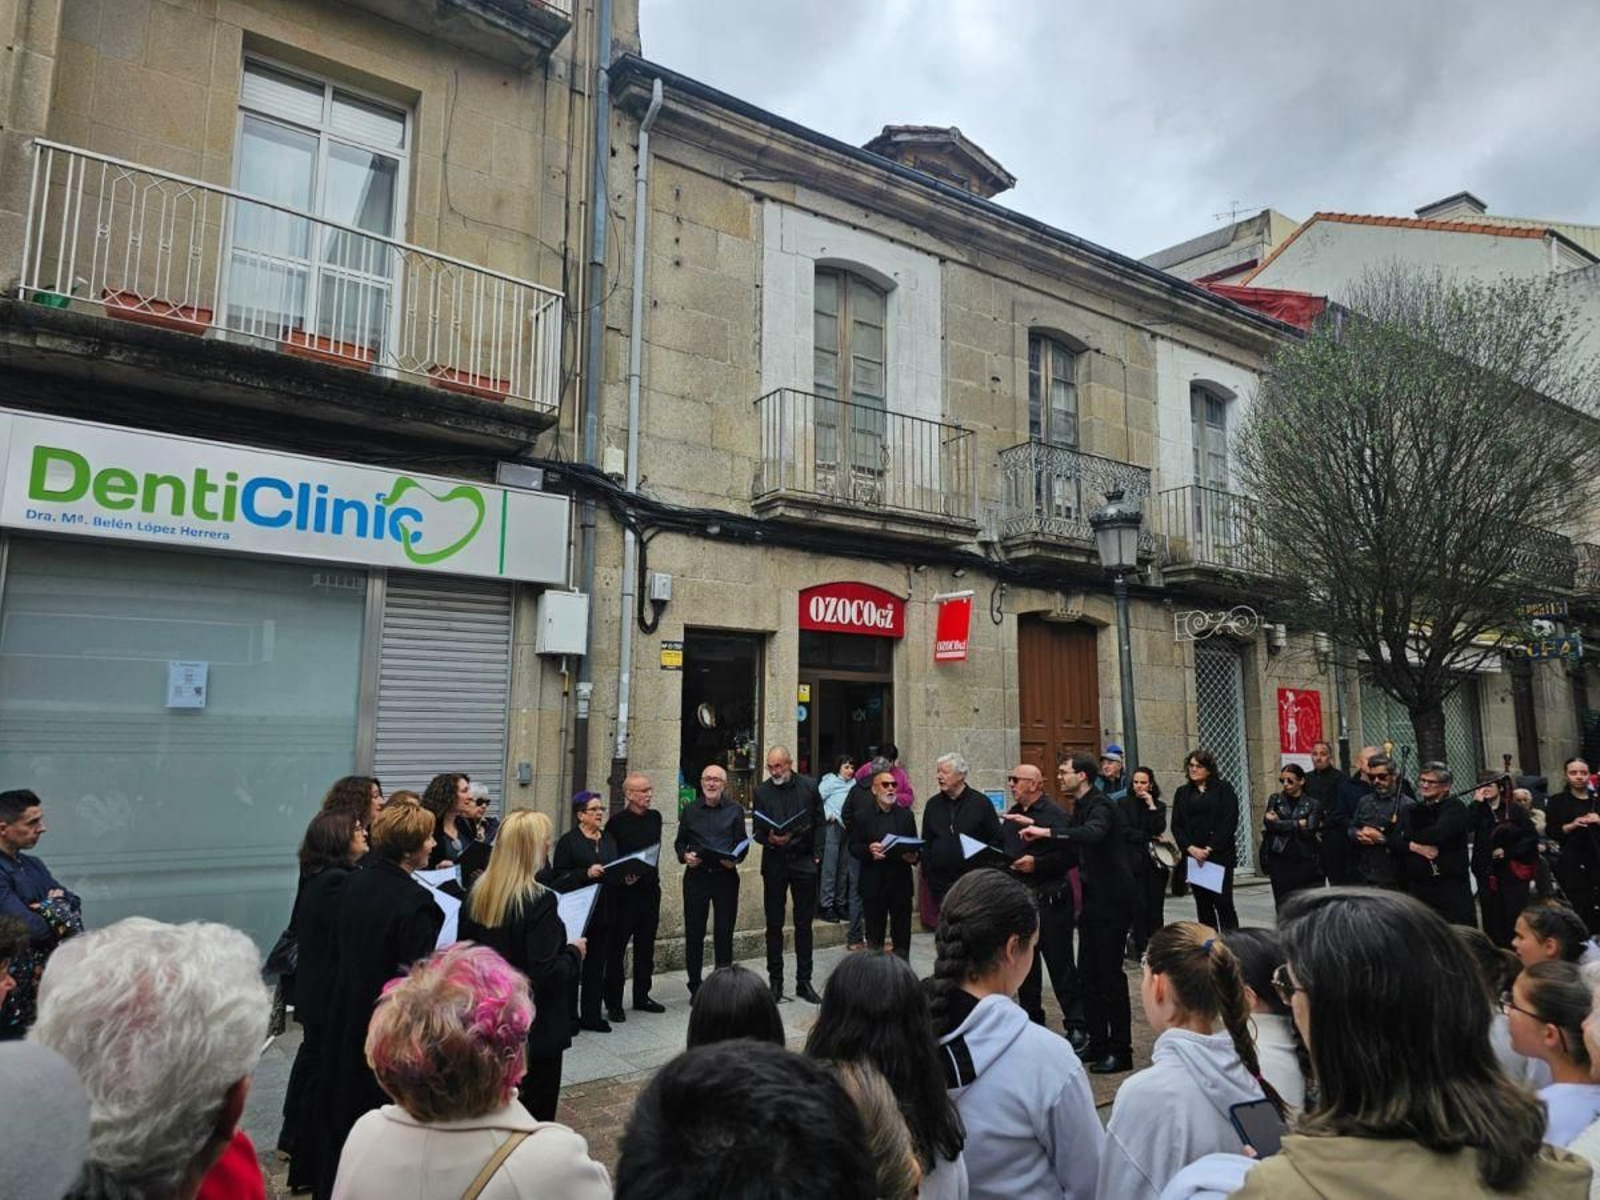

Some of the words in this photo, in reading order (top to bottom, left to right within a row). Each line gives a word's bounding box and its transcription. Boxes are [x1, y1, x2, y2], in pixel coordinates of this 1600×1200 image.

[26, 508, 56, 522] Dra.
[93, 515, 133, 530] Belén
[137, 518, 176, 535] López
[180, 526, 231, 541] Herrera
[28, 445, 423, 544] DentiClinic
